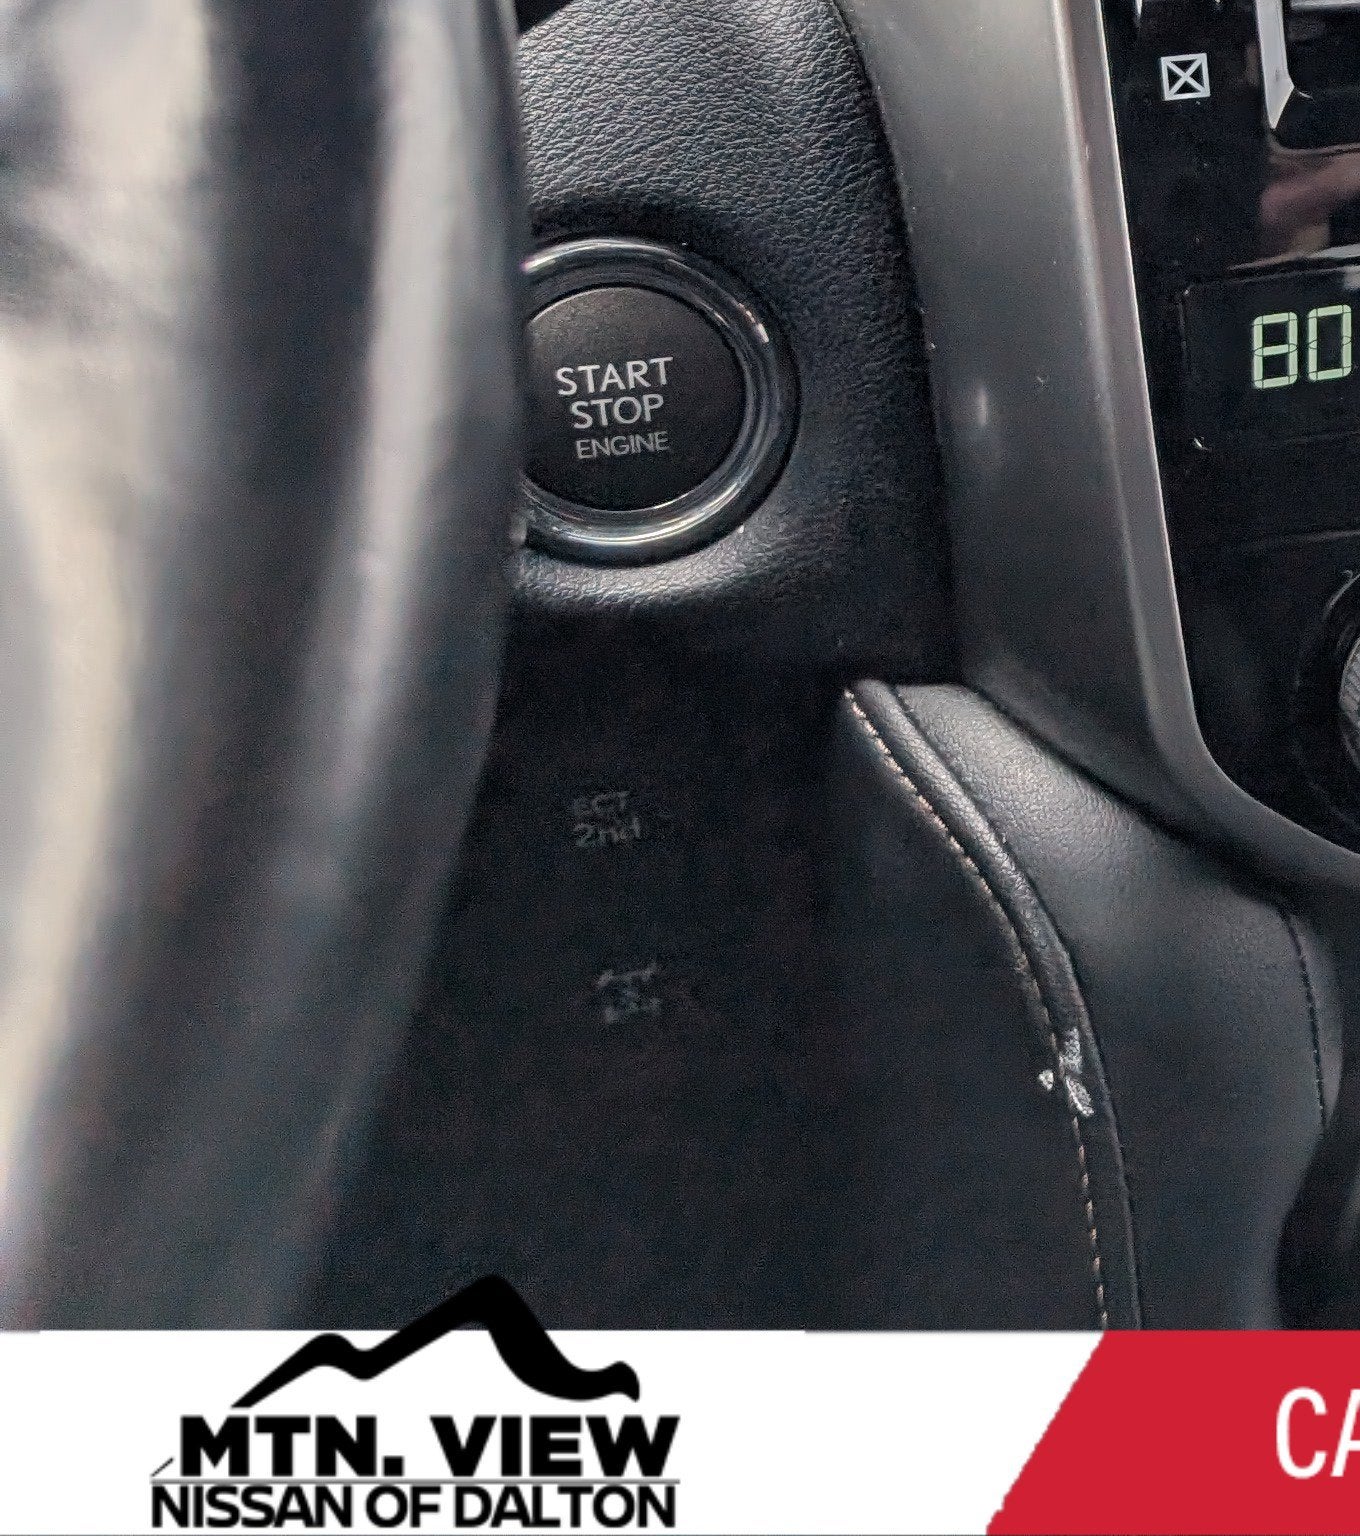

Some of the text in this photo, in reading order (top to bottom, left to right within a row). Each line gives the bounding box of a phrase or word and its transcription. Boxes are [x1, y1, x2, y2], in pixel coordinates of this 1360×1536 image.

[1252, 304, 1352, 389] 80
[556, 357, 673, 395] START
[570, 394, 664, 429] STOP
[576, 430, 670, 459] ENGINE
